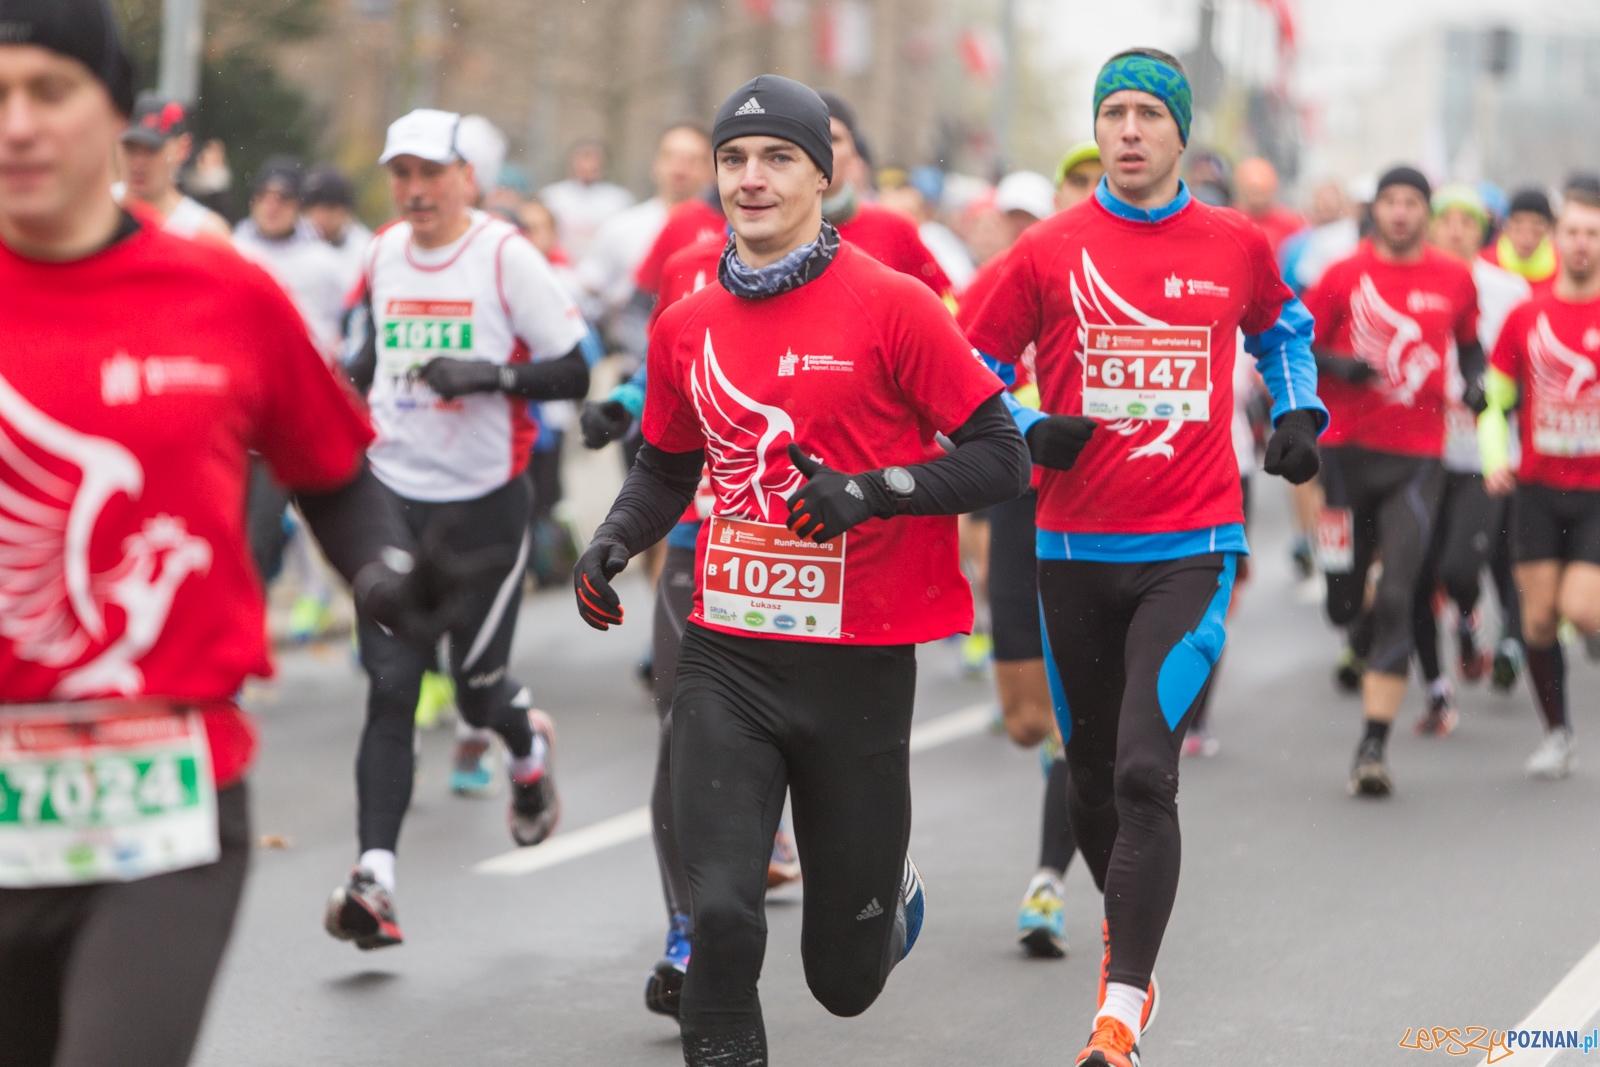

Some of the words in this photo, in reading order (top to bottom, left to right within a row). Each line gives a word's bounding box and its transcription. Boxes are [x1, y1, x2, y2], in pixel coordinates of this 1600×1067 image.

[735, 108, 765, 116] adidas
[392, 322, 461, 348] 1011
[1152, 337, 1202, 348] RunPoland.org
[802, 354, 810, 370] 1
[1088, 365, 1098, 377] B
[1101, 357, 1197, 389] 6147
[707, 563, 718, 576] B
[722, 556, 826, 599] 1029
[710, 606, 728, 615] GRUPA
[750, 600, 782, 611] Łukasz
[3, 754, 183, 826] 7024
